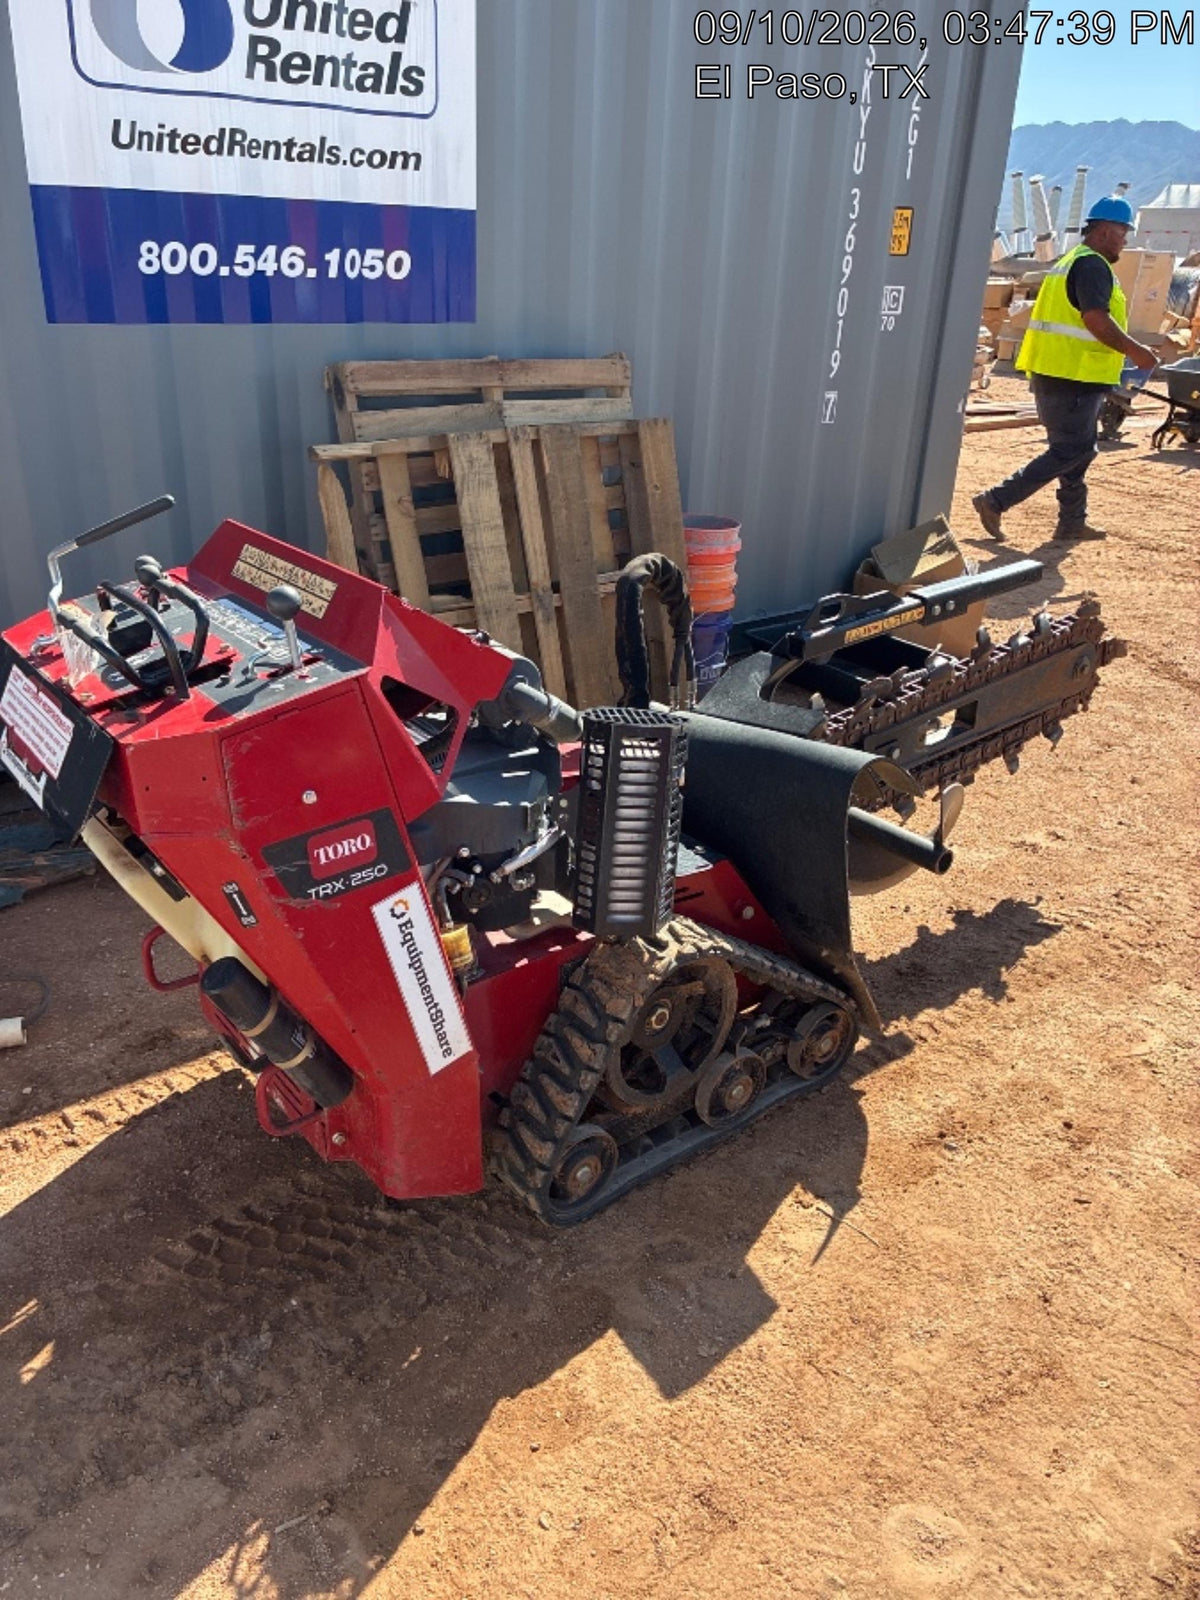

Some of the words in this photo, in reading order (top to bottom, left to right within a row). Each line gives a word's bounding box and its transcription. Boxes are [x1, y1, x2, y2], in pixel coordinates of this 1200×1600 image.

[243, 0, 411, 44] United
[245, 33, 426, 97] Rentals
[111, 119, 423, 172] UnitedRentals.com
[137, 240, 412, 280] 800.546.1050
[829, 190, 861, 378] 369019
[880, 316, 896, 332] 70
[313, 833, 372, 865] TORO
[397, 917, 454, 1059] EquipmentShare
